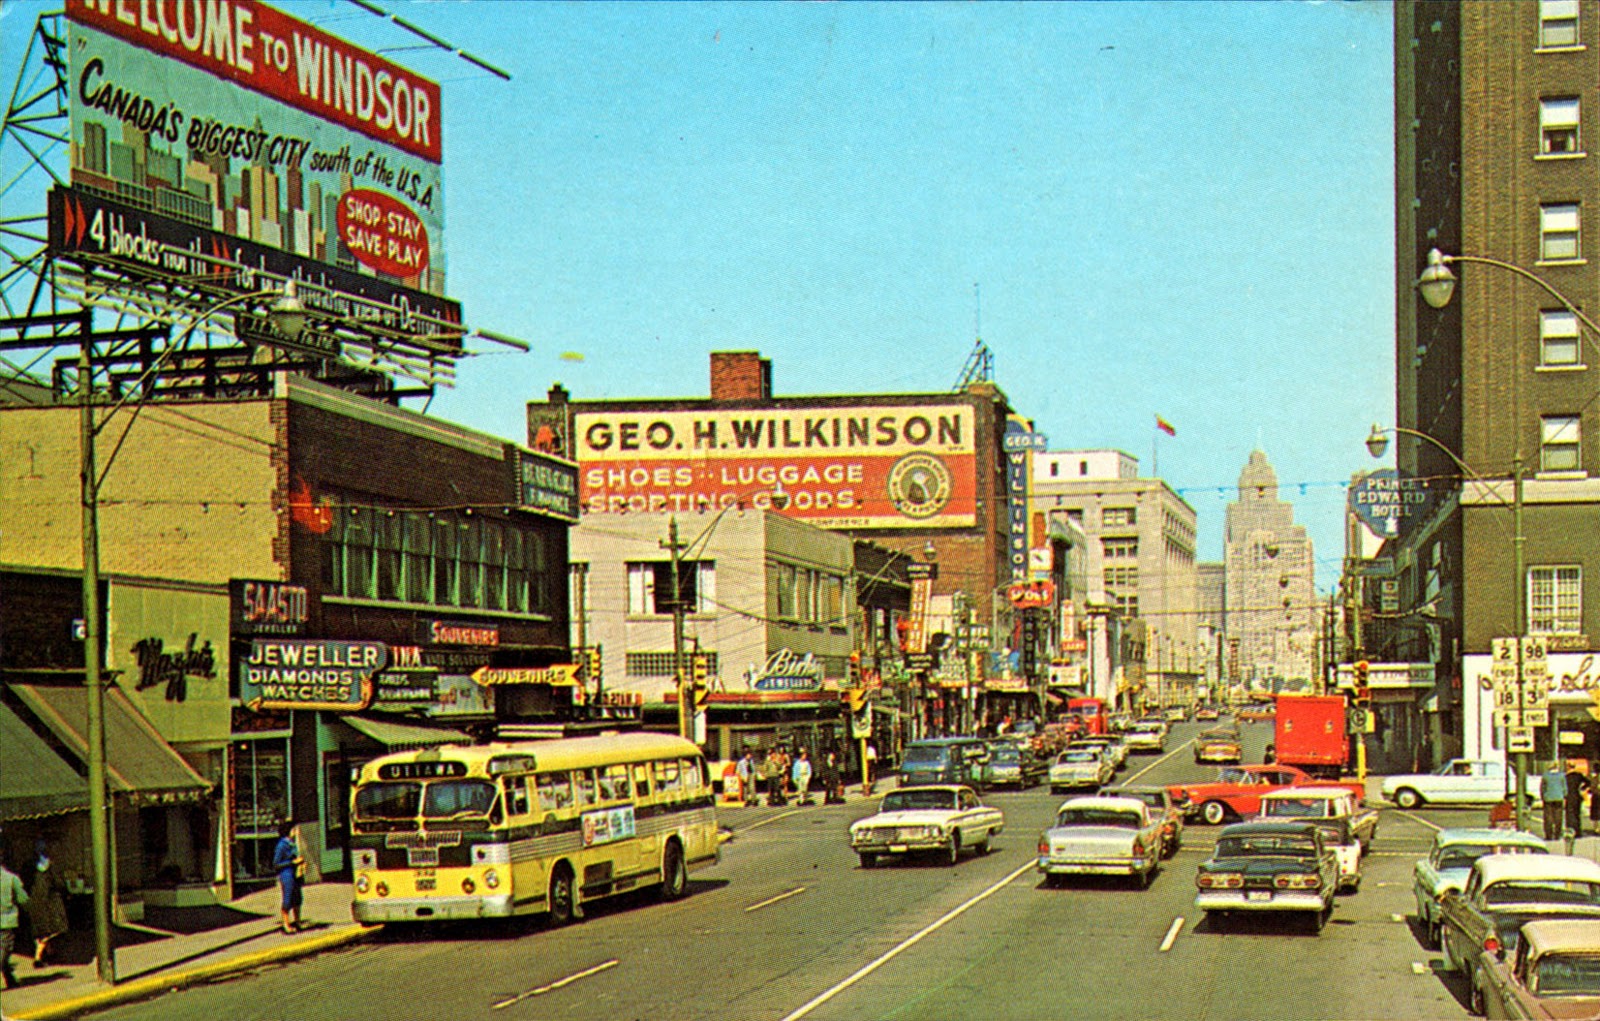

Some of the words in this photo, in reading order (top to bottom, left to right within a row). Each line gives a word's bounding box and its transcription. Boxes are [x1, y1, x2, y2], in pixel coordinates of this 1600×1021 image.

[84, 0, 253, 75] LCOME
[259, 31, 290, 73] TO
[293, 31, 431, 148] WINDSOR
[79, 57, 184, 143] CANADA'S
[186, 115, 268, 162] BIGGEST
[268, 135, 311, 168] CITY
[309, 144, 351, 174] south
[353, 149, 374, 176] of
[372, 156, 394, 188] the
[346, 196, 381, 228] SHOP
[387, 210, 423, 242] STAY
[89, 208, 106, 250] 4
[109, 210, 160, 266] blocks
[346, 223, 382, 256] SAVE
[387, 237, 424, 269] PLAY
[585, 420, 684, 451] GEO.
[586, 466, 693, 488] SHOES
[720, 464, 865, 487] LUGGAGE
[1366, 478, 1417, 490] PRINCE
[1357, 491, 1426, 504] EDWARD
[1371, 504, 1412, 517] HOTEL
[248, 644, 379, 667] JEWELLER
[1499, 646, 1511, 660] 2
[1524, 645, 1544, 659] 98
[247, 668, 353, 686] DIAMONDS
[262, 684, 351, 701] WATCHES
[1499, 691, 1514, 705] 18
